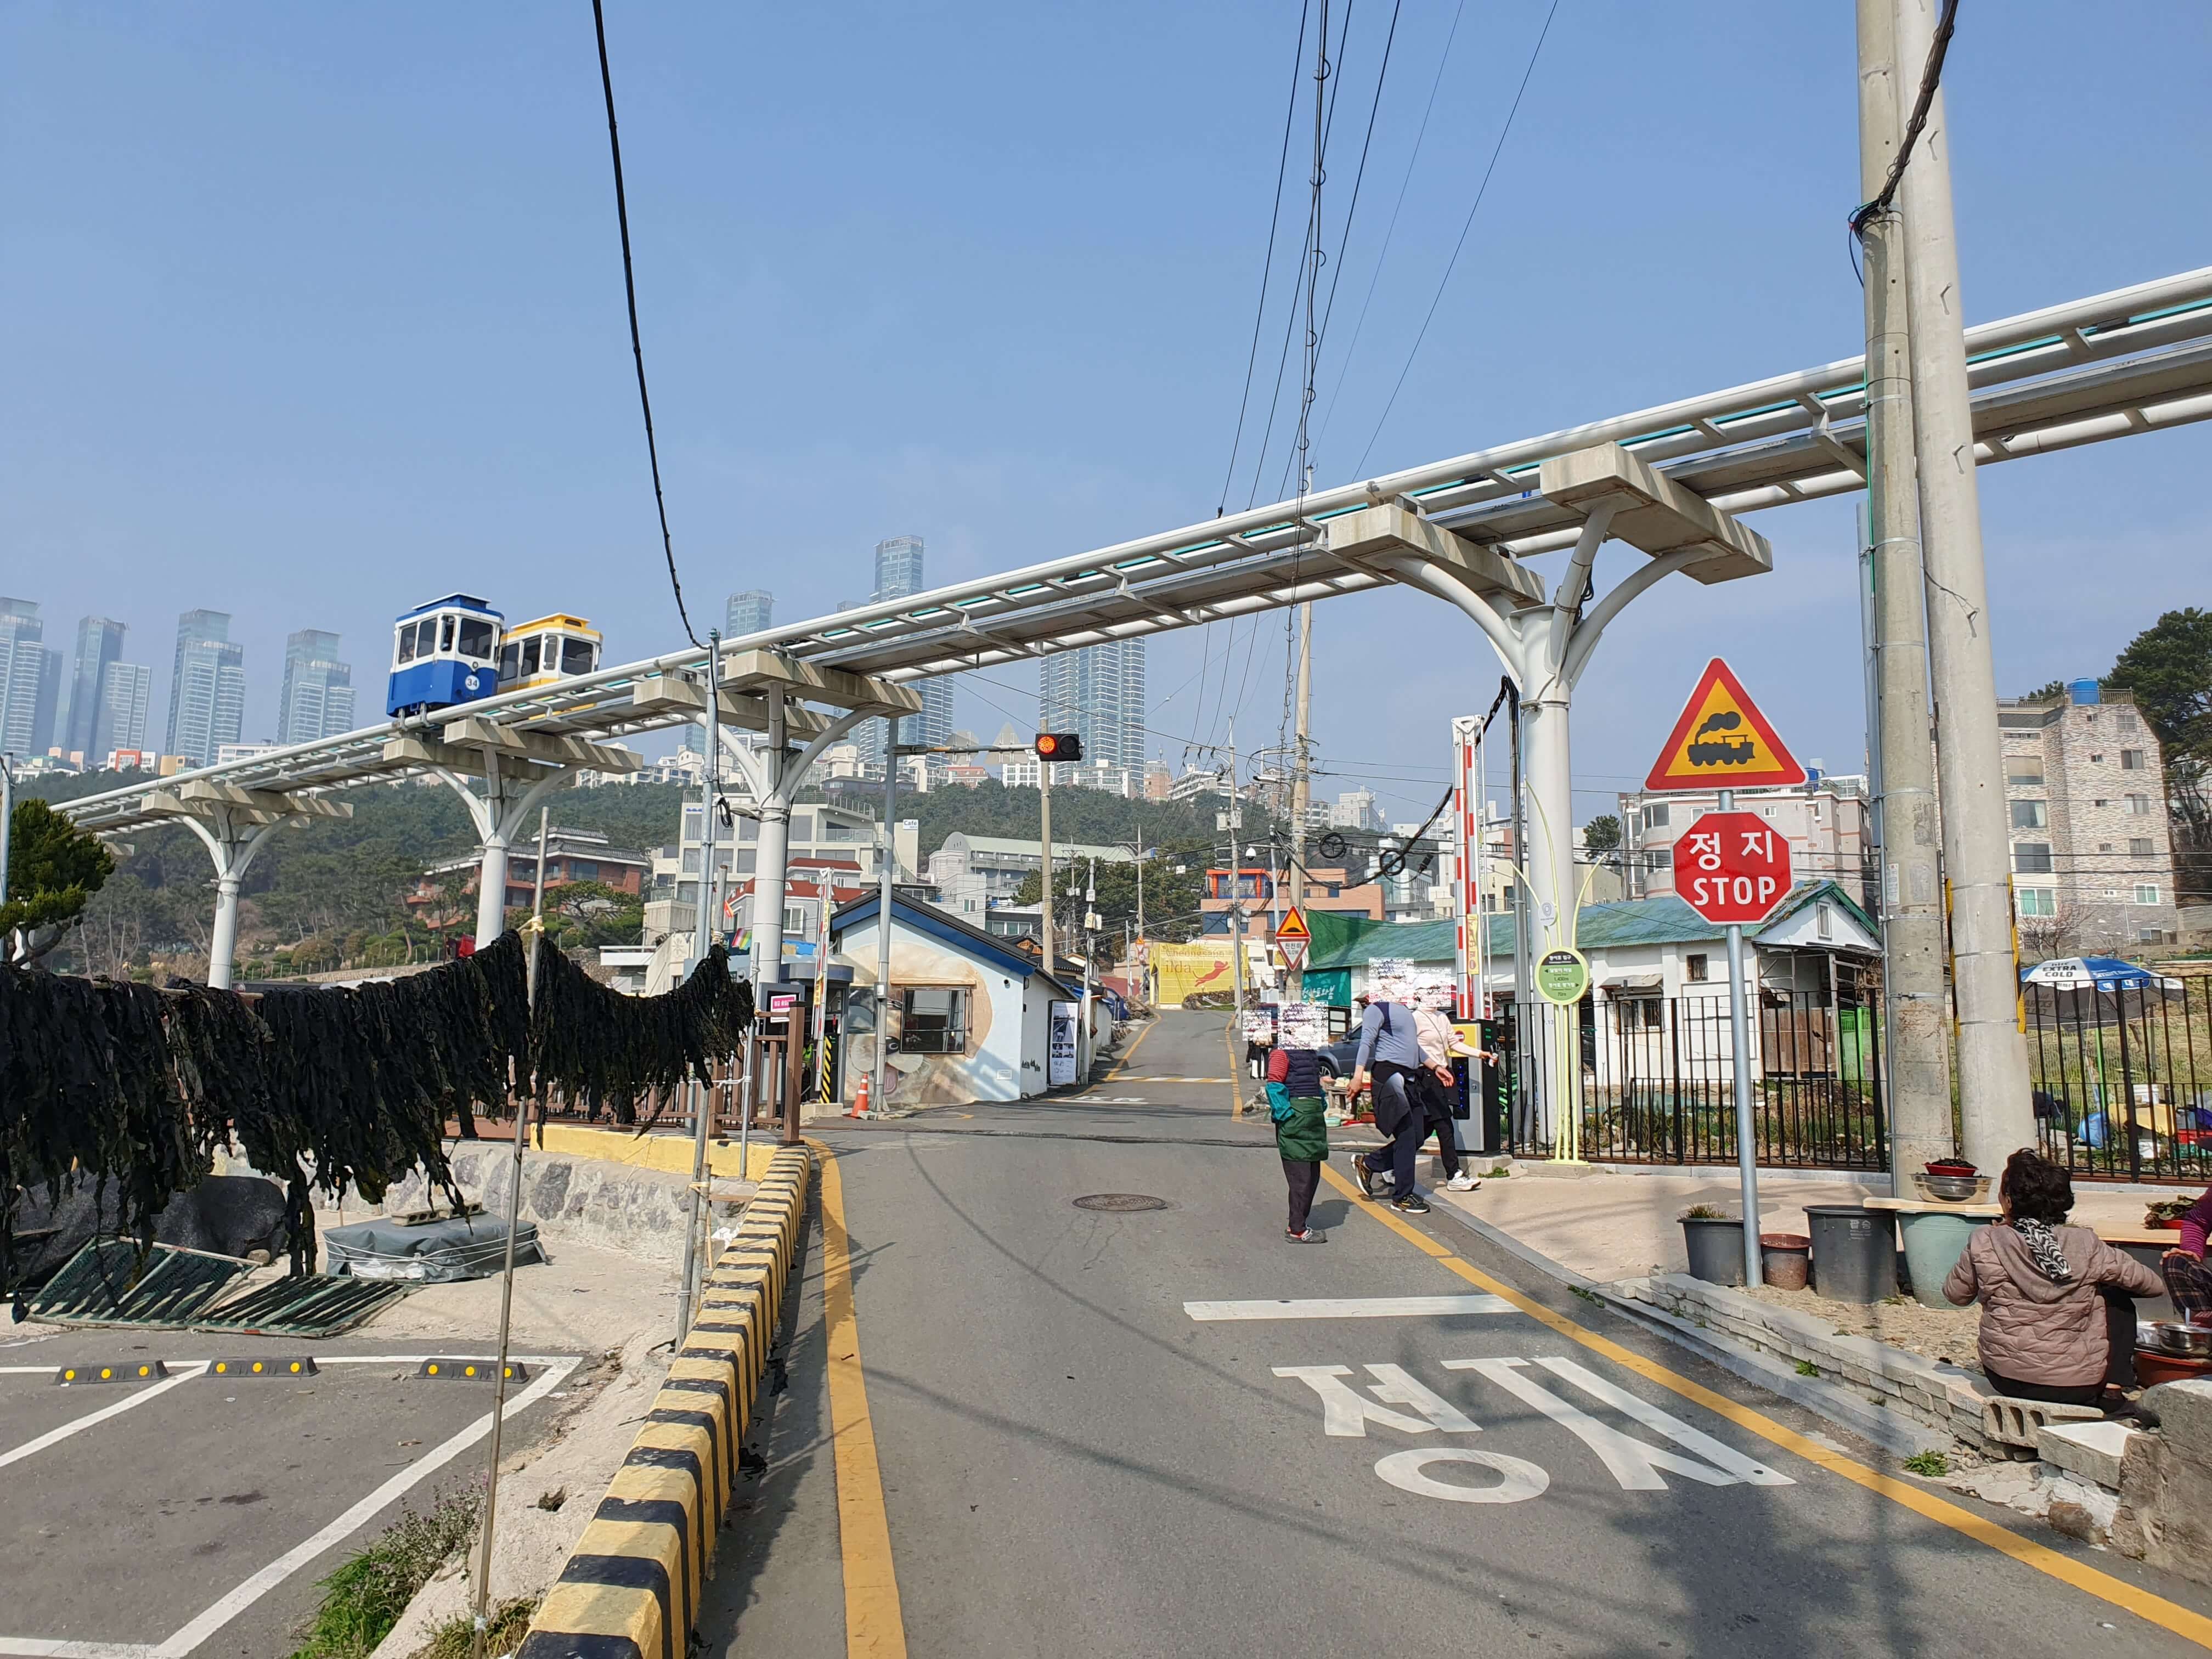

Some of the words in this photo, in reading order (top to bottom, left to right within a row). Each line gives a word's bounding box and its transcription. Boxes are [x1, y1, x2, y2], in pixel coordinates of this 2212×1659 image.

[466, 678, 478, 688] 34
[1689, 830, 1774, 870] 정지
[1694, 876, 1776, 907] STOP
[1165, 960, 1191, 973] ilda
[1271, 1355, 1797, 1503] 정지
